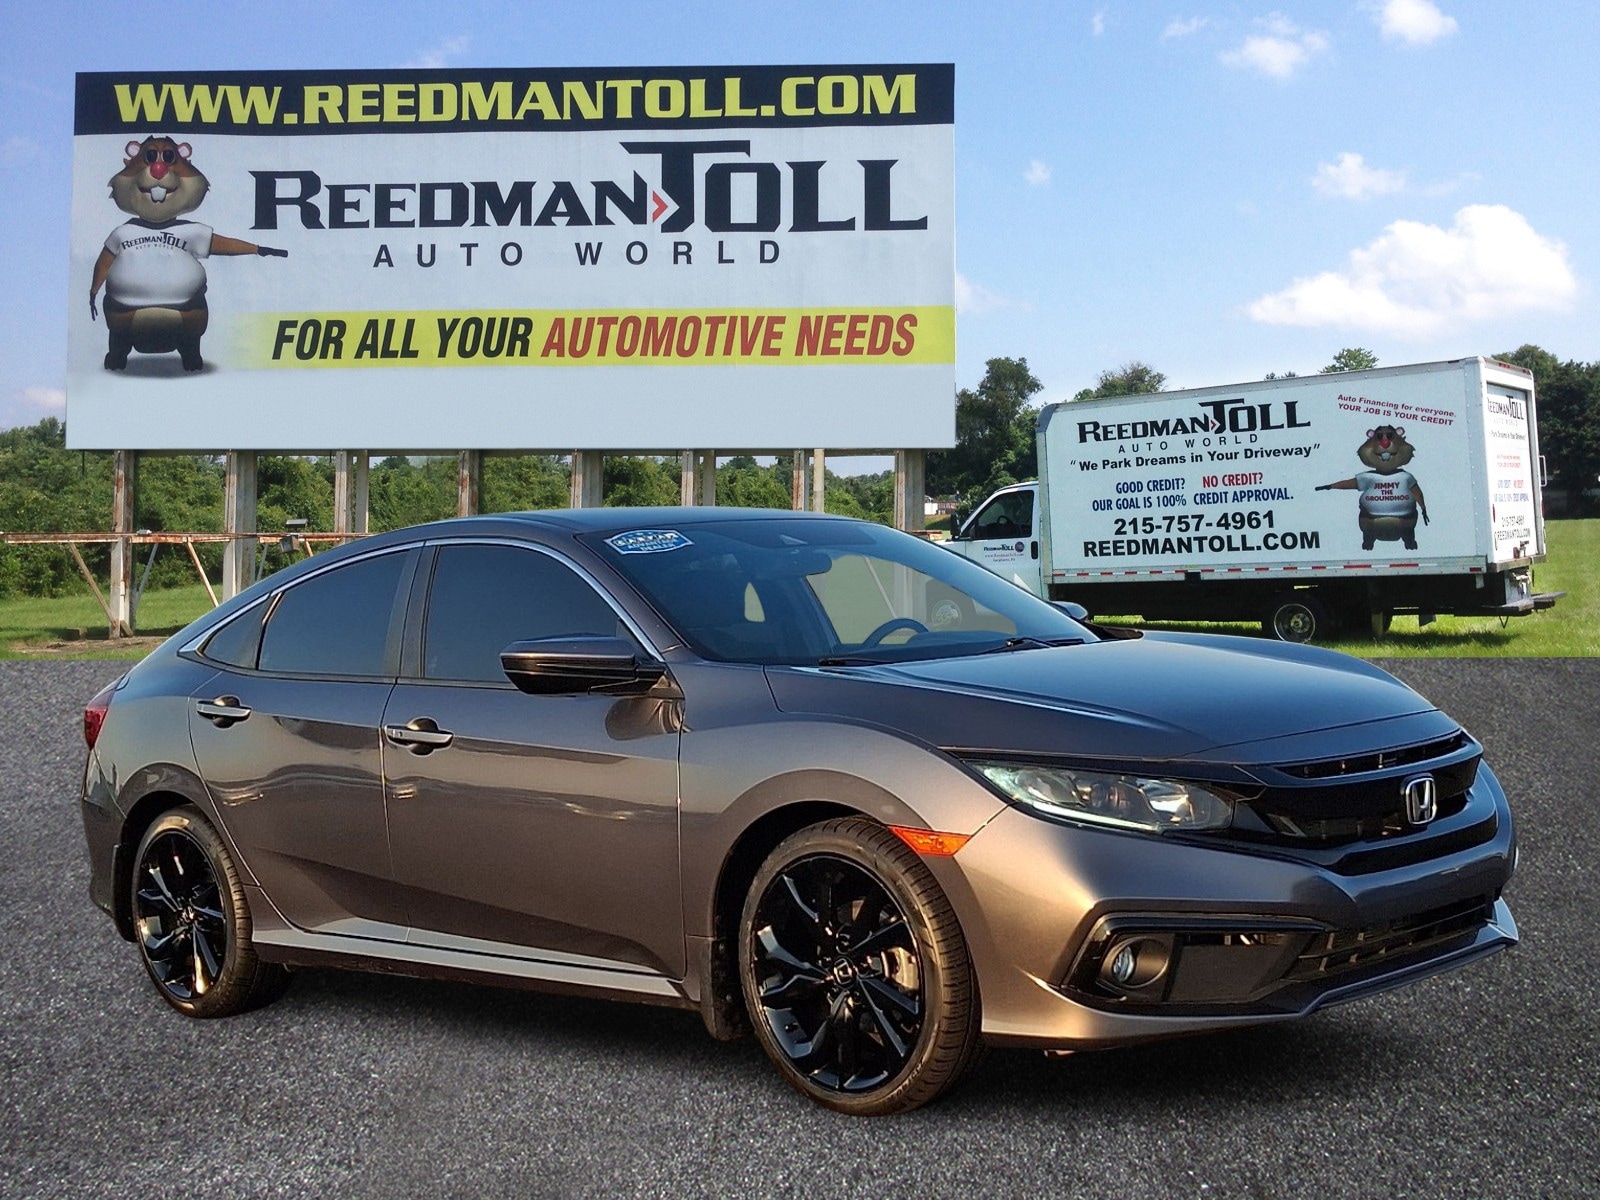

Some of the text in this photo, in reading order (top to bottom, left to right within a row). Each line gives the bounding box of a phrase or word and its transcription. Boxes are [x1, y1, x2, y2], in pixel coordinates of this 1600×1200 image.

[114, 74, 916, 124] WWW.REEDMANTOLL.COM
[373, 240, 781, 268] AUTO WORLD
[272, 313, 918, 360] FOR ALL YOUR AUTOMOTIVE NEEDS
[1338, 394, 1457, 418] Auto Financing for everyone.
[1338, 403, 1454, 426] YOUR JOB IS YOUR CREDIT
[1118, 433, 1258, 453] AUTO WORLD
[1102, 458, 1132, 470] Park
[1136, 454, 1186, 467] Dreams
[1190, 452, 1203, 463] in
[1207, 450, 1240, 462] Your
[1115, 472, 1264, 494] GOOD CREDIT? NO CREDIT?
[1374, 481, 1400, 490] JIMMY
[1092, 487, 1294, 511] OUR GOAL IS 100% CREDIT APPROVAL.
[1365, 494, 1410, 502] GROUNDHOG
[1114, 510, 1275, 536] 215-757-4961
[1082, 531, 1321, 557] REEDMANTOLL.COM
